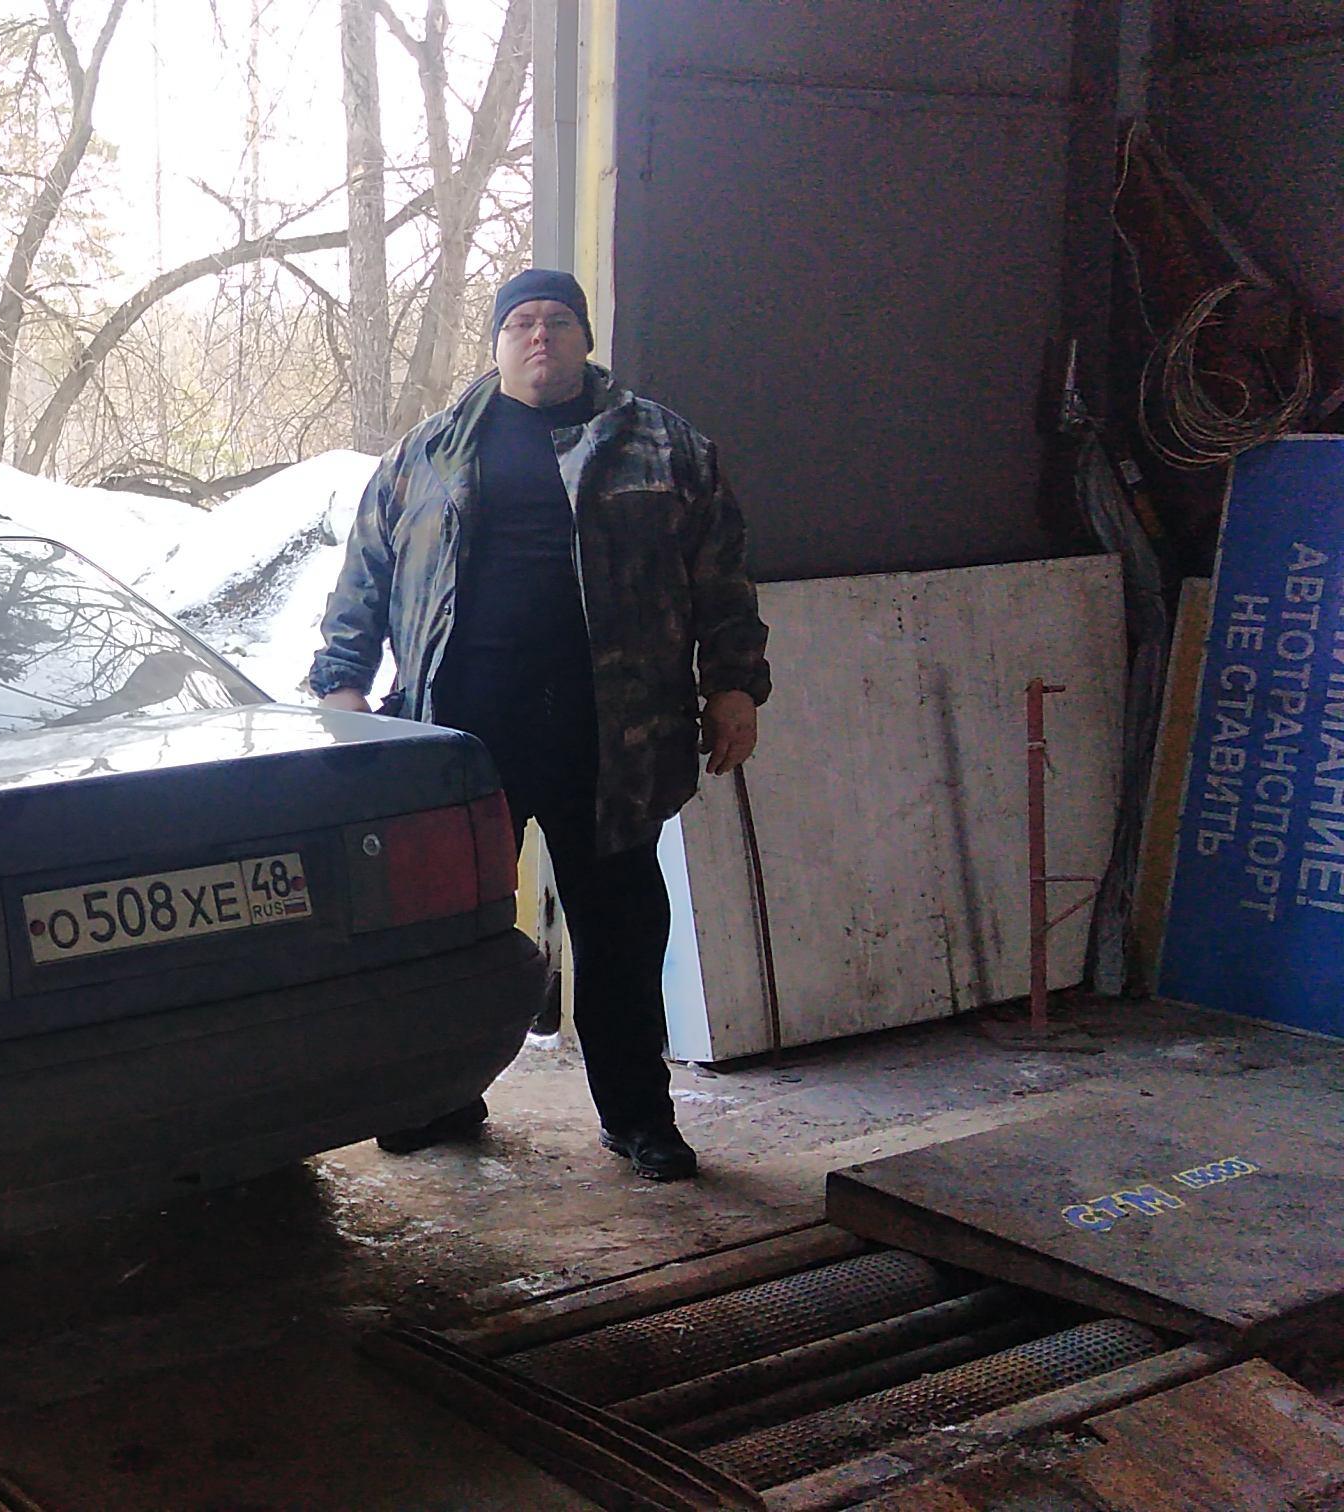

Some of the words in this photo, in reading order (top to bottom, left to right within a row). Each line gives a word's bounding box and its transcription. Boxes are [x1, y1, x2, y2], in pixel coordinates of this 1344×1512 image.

[1226, 593, 1270, 650] НЕ
[1196, 664, 1257, 856] СТАВИТЬ
[1240, 541, 1329, 922] АВТОТРАНСПОРТ
[1296, 597, 1344, 913] АНИЕ!
[251, 859, 290, 901] 48
[252, 901, 284, 919] RUS
